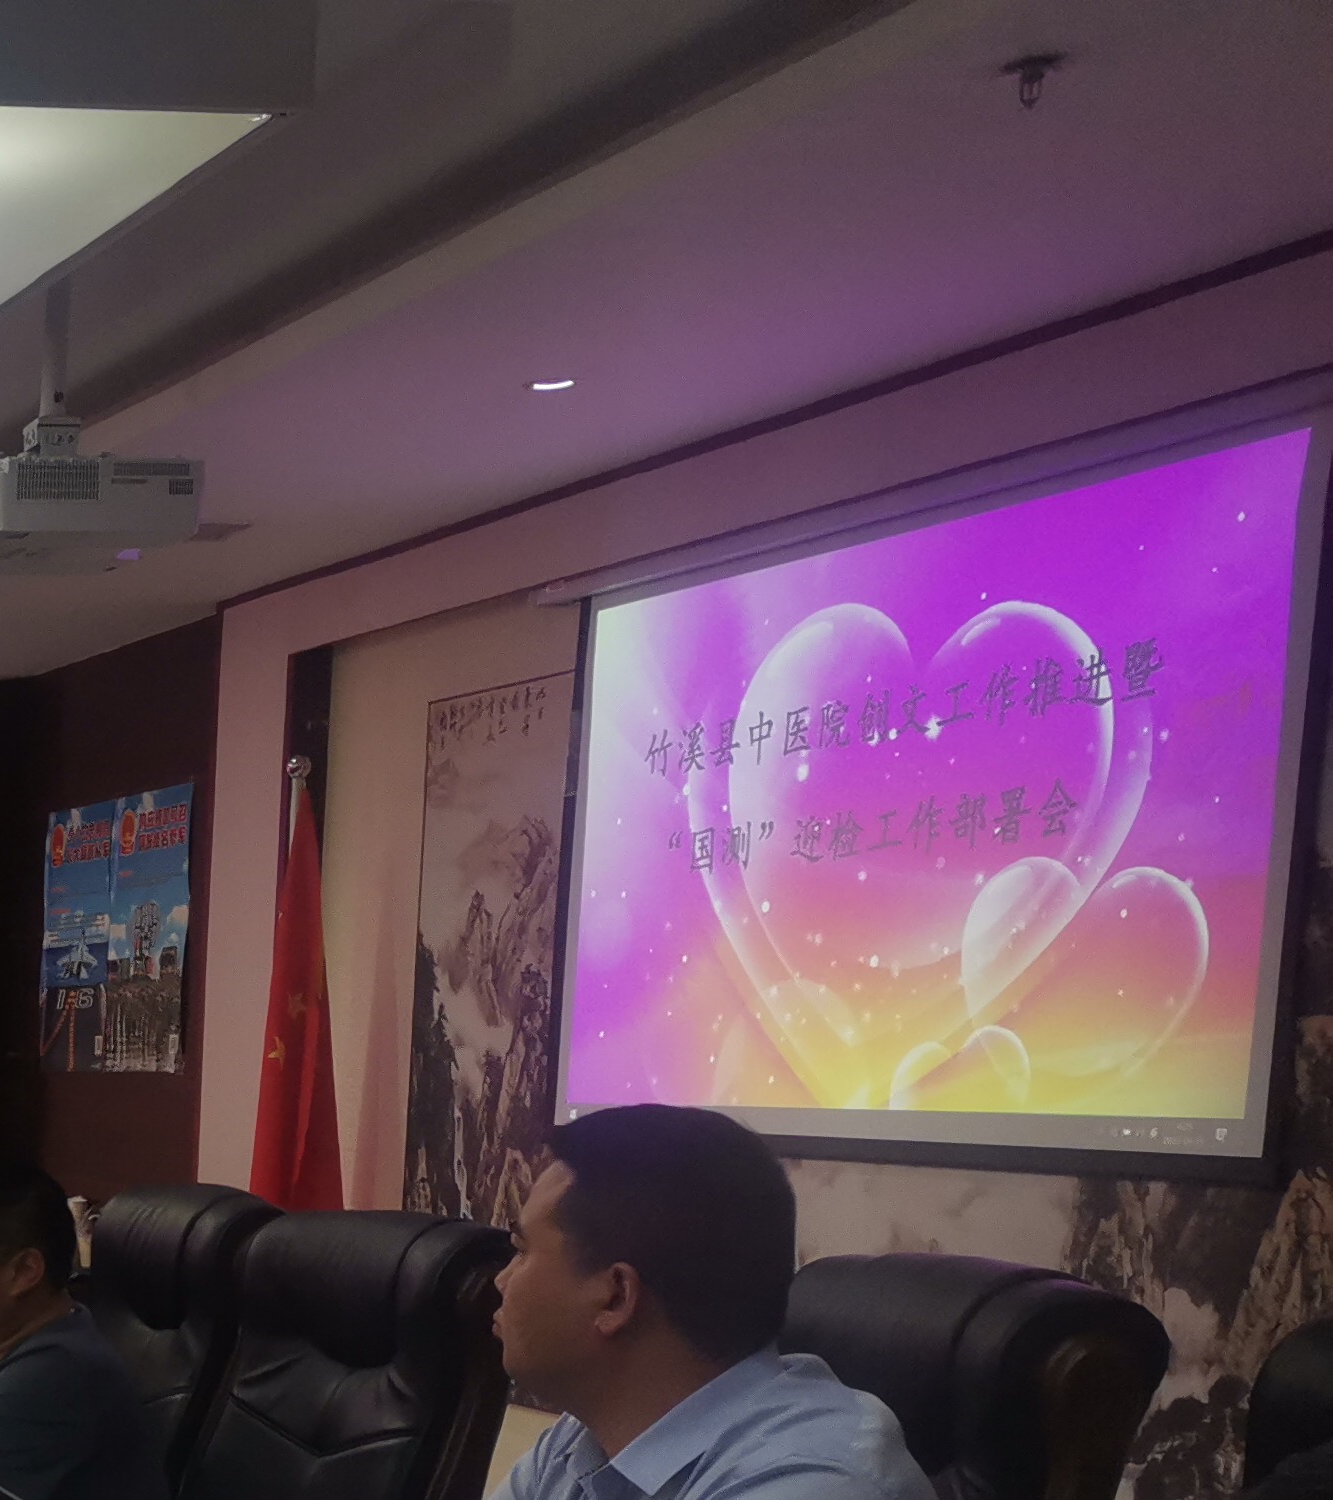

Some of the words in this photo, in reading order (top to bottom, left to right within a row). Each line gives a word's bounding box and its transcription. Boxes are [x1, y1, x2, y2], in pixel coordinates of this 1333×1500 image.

[644, 636, 1165, 776] 竹溪县中医院创文工作推进暨
